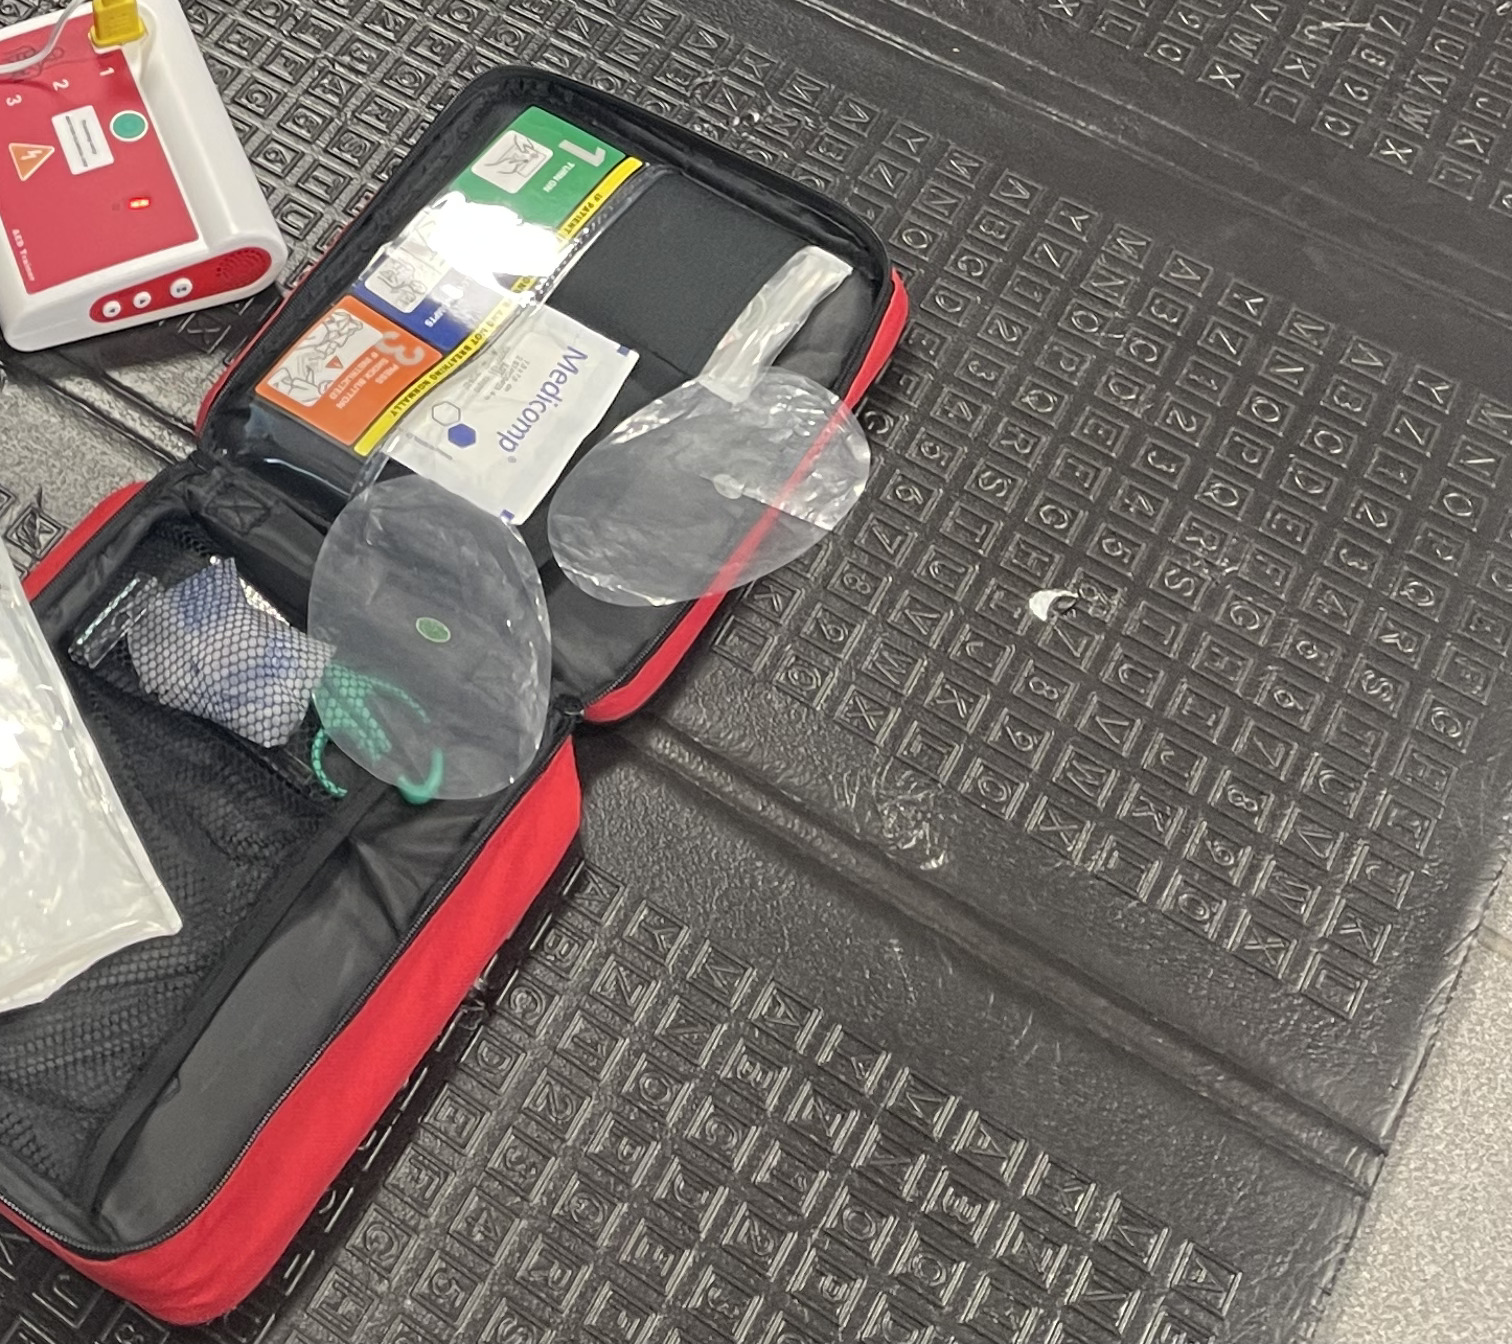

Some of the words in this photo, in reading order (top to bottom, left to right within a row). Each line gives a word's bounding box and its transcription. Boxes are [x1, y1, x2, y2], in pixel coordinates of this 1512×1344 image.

[53, 78, 69, 92] 2
[99, 65, 115, 77] 1
[6, 93, 22, 107] 3
[558, 139, 606, 168] 1
[564, 201, 594, 235] PATIENT
[375, 331, 425, 366] 3
[429, 344, 473, 381] BREATHING
[390, 378, 431, 418] NORMALLY
[496, 346, 589, 453] Medicomp
